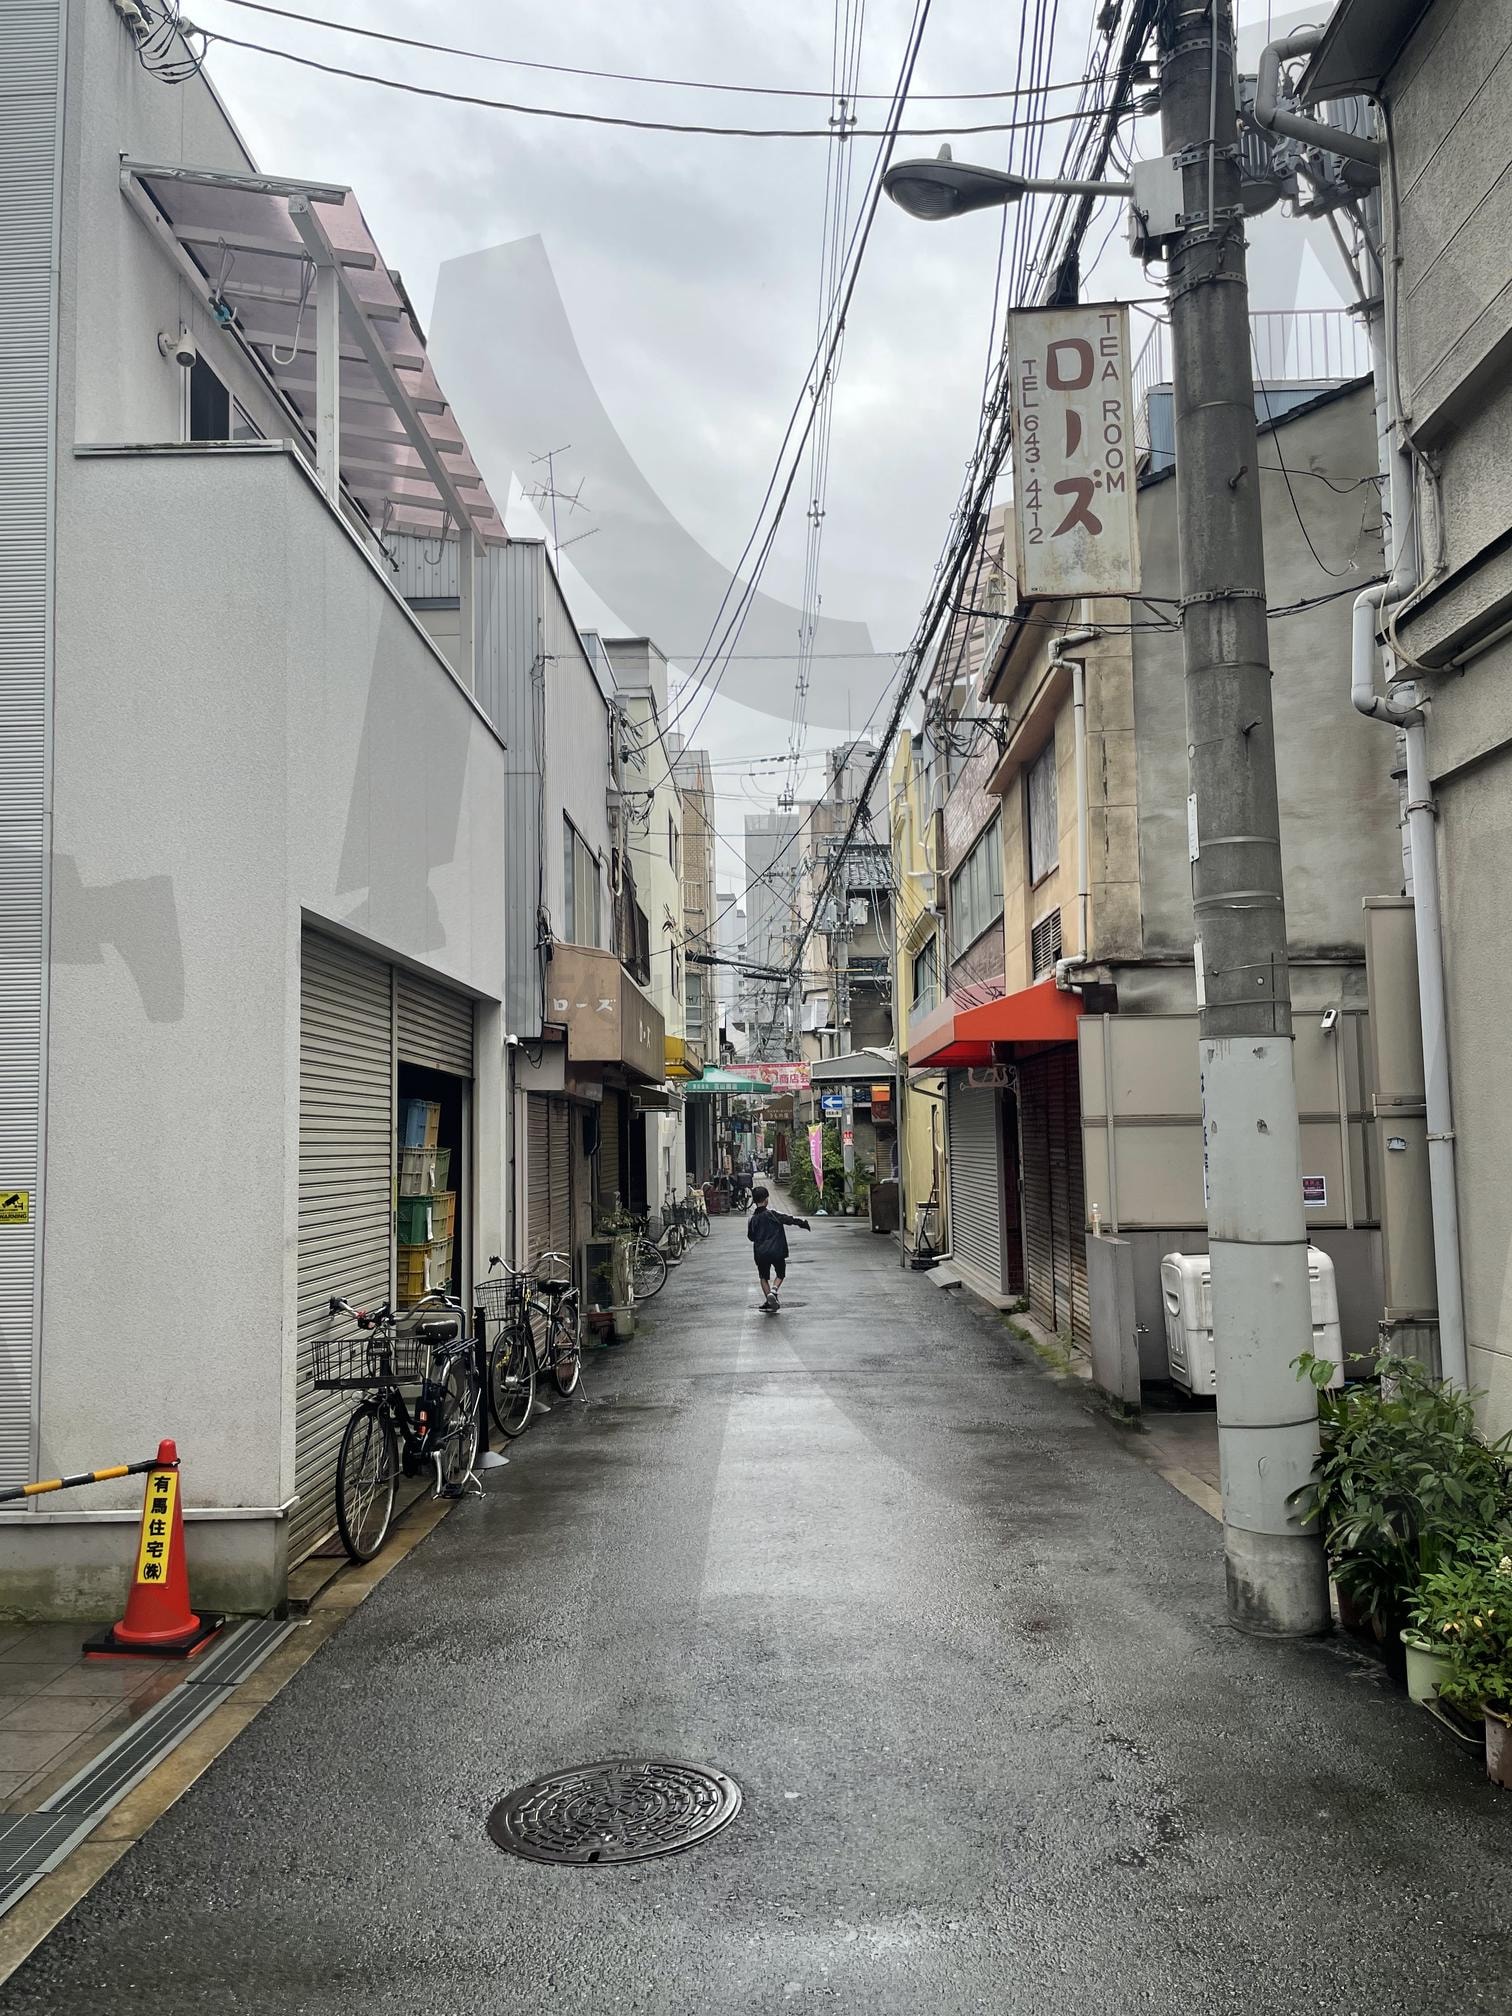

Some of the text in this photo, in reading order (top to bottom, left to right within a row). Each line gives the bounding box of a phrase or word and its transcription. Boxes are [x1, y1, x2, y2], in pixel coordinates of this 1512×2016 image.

[1021, 358, 1039, 408] TEL
[1045, 338, 1103, 538] ローズ
[1098, 313, 1125, 494] TEA ROOM
[553, 997, 617, 1013] ローズ
